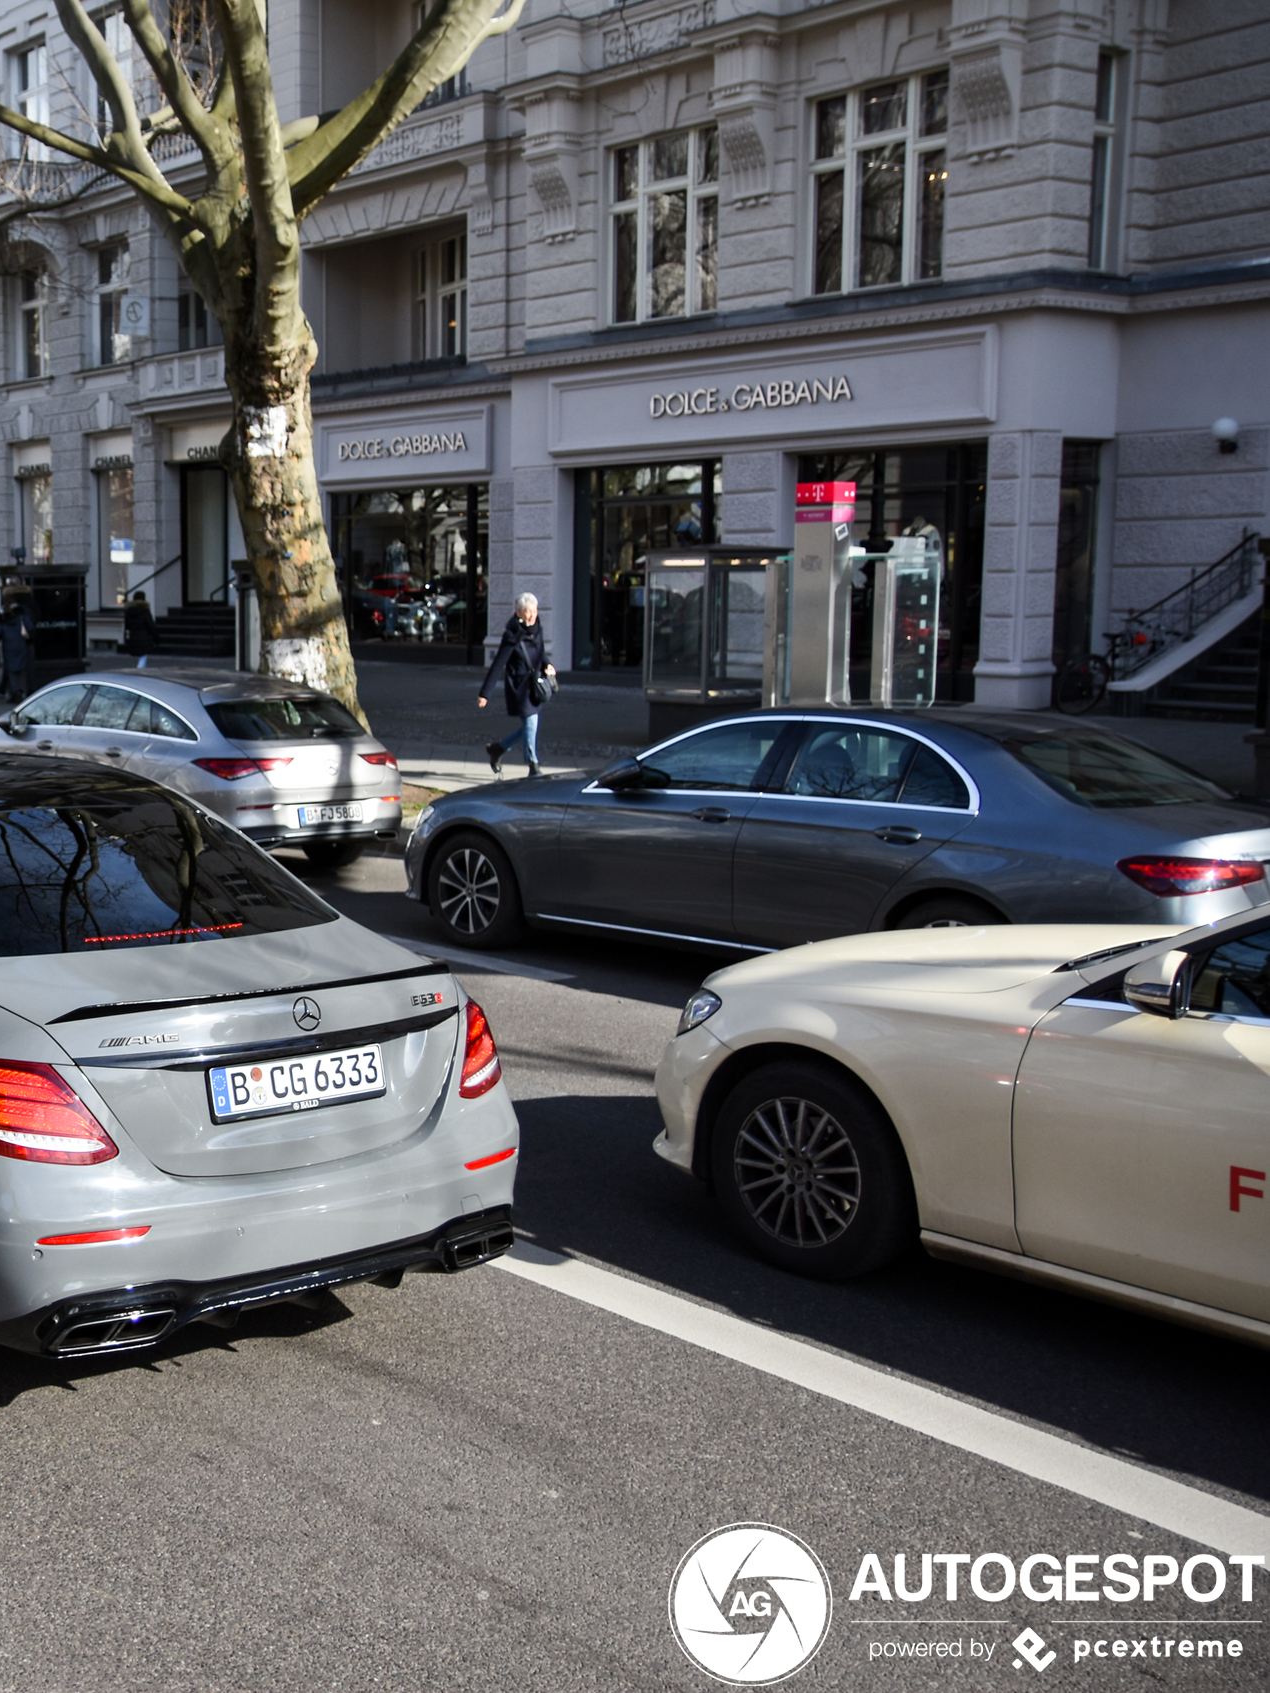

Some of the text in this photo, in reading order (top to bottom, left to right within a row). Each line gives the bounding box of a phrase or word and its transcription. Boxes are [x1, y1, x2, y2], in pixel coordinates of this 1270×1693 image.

[649, 375, 854, 419] DOLCE & GABBANA
[187, 444, 219, 460] CHAN
[338, 439, 383, 461] DOLCE
[390, 431, 468, 458] GABBANA
[95, 454, 132, 468] CHANEL
[306, 809, 315, 822] B
[320, 808, 334, 820] FJ
[231, 1052, 378, 1106] B CG 6333
[218, 1096, 226, 1107] D
[300, 1100, 319, 1109] BALD
[1229, 1165, 1266, 1213] F
